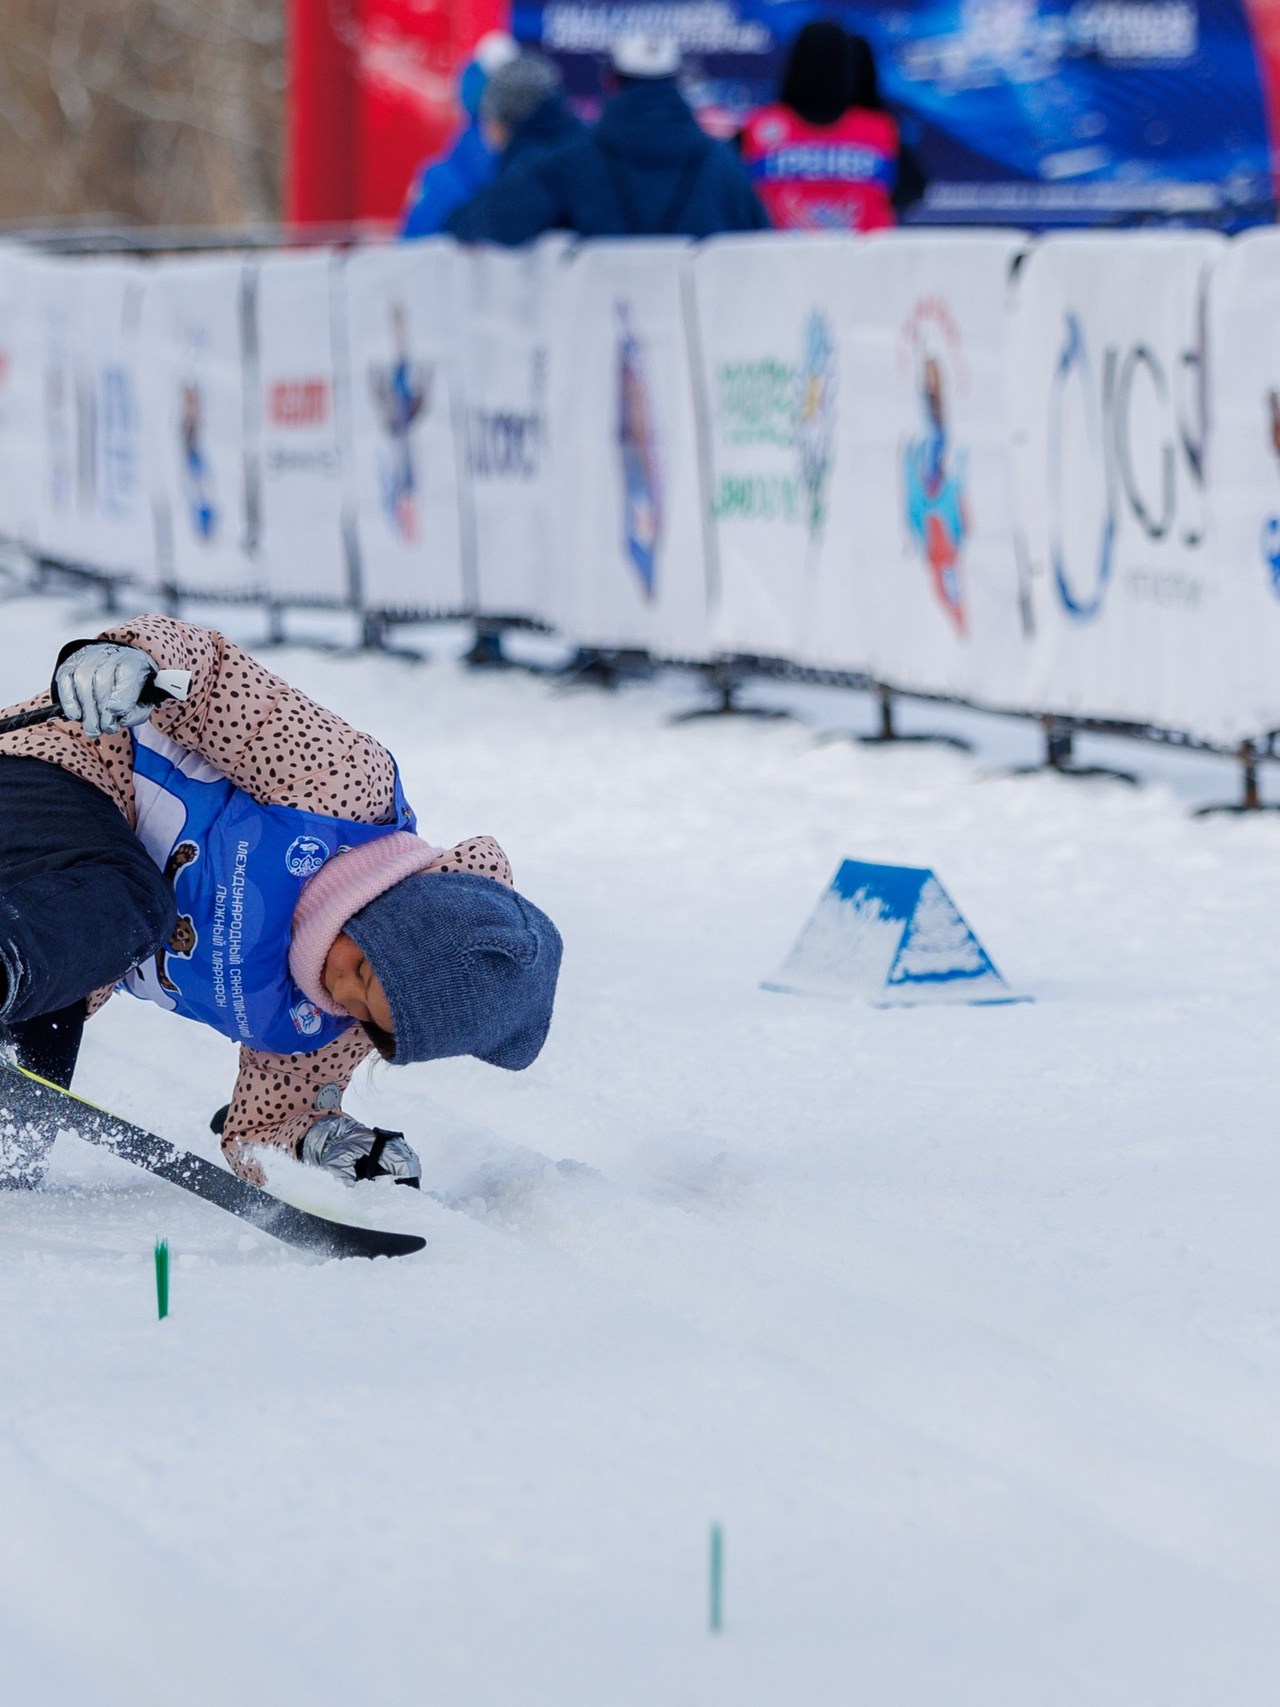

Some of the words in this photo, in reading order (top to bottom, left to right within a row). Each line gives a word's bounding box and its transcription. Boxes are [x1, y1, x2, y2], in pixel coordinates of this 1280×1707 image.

[212, 884, 227, 947] ЛЫЖНЫЙ
[228, 840, 249, 965] МЕЖДУНАРОДНЫЙ
[211, 949, 227, 1008] МАРАФОН
[229, 968, 254, 1038] САХАЛИНСКИЙ
